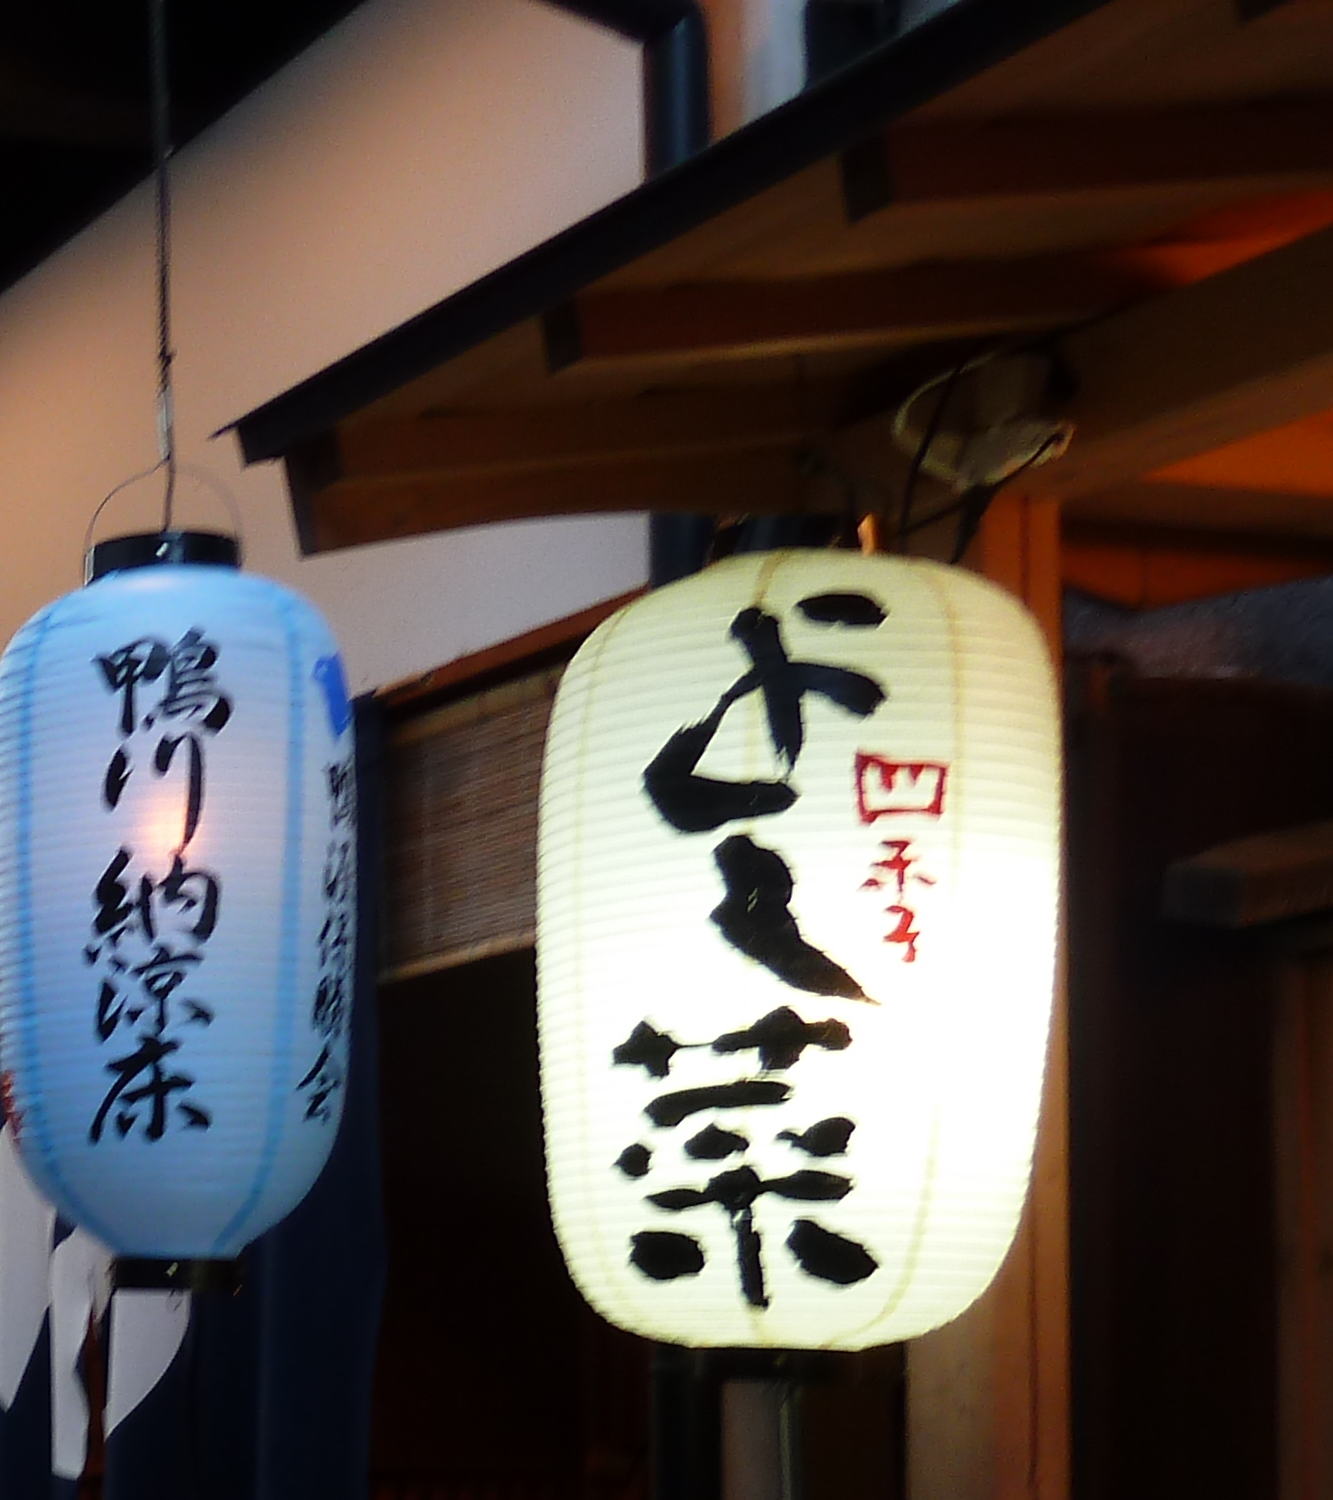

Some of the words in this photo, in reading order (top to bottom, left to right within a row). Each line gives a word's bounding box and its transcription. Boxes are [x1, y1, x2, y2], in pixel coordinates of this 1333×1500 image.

[83, 627, 231, 1146] 鴨川納涼床
